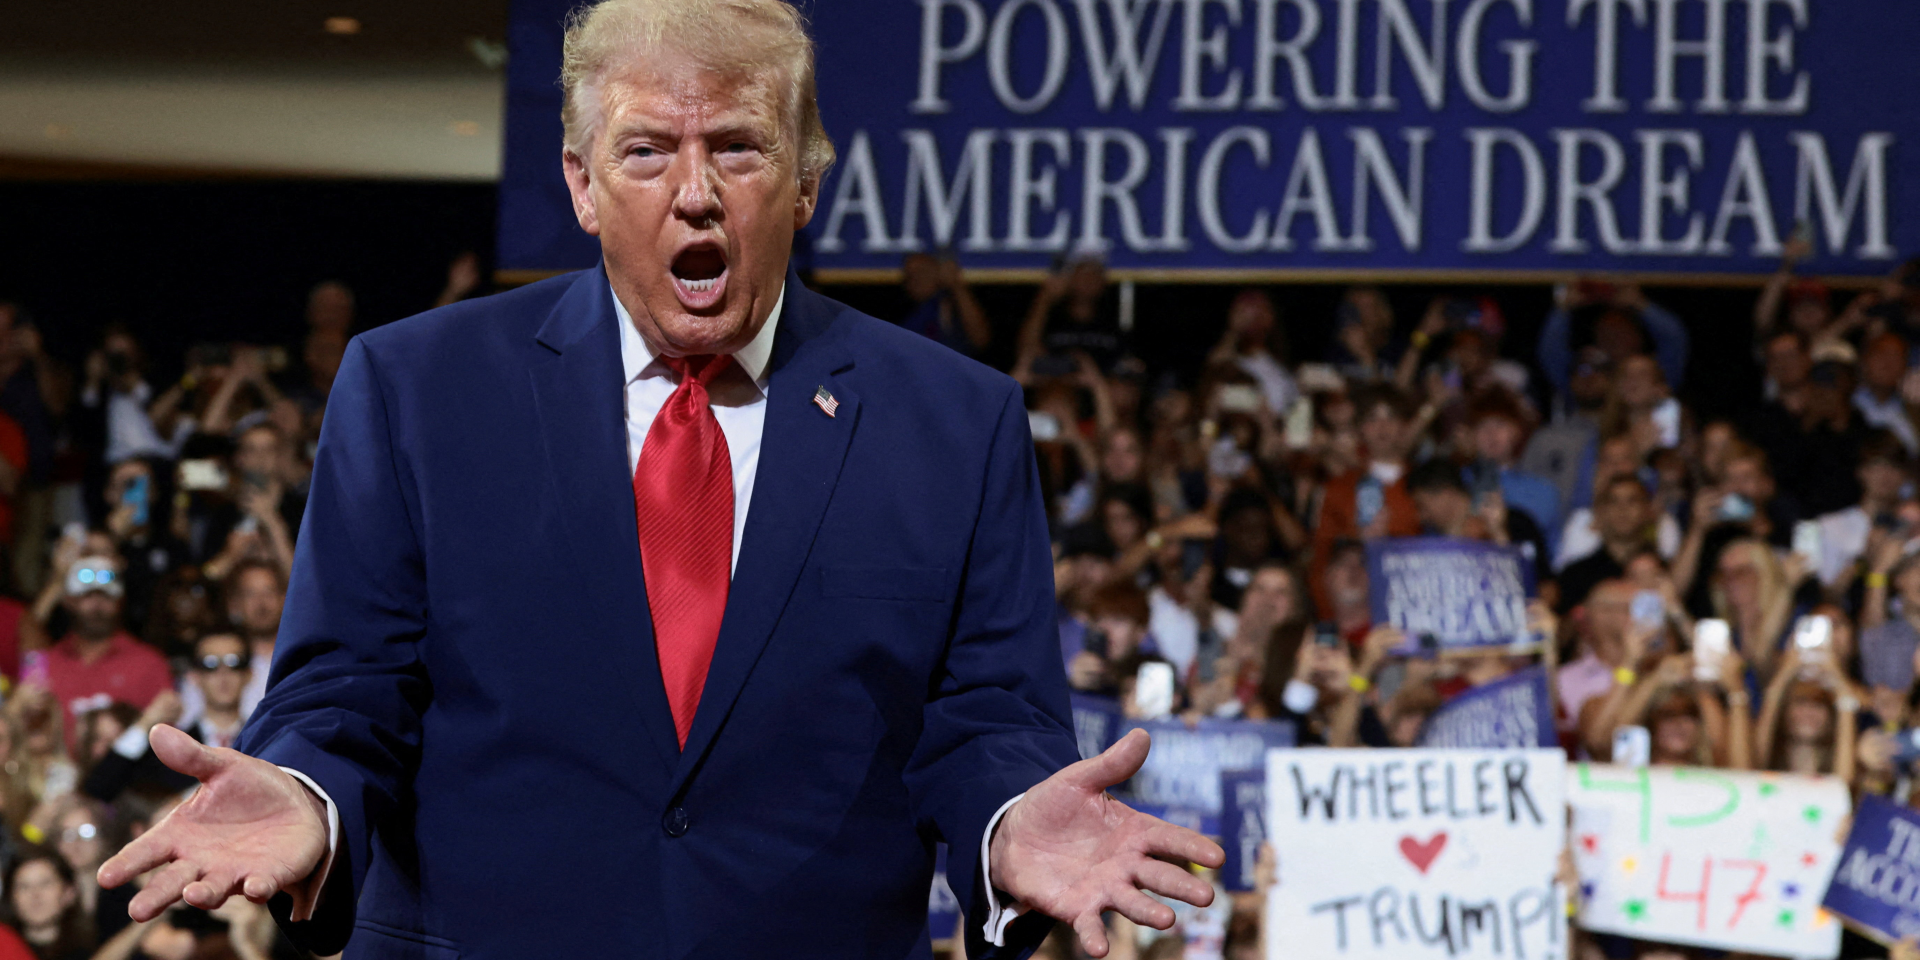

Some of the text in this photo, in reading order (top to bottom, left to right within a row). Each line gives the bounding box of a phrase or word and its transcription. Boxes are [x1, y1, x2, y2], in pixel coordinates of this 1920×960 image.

[909, 0, 1811, 114] POWERING THE
[813, 127, 1895, 260] AMERICAN DREAM
[1387, 595, 1529, 643] DREAM
[1289, 757, 1543, 825] WHEELER
[1656, 853, 1768, 932] 47
